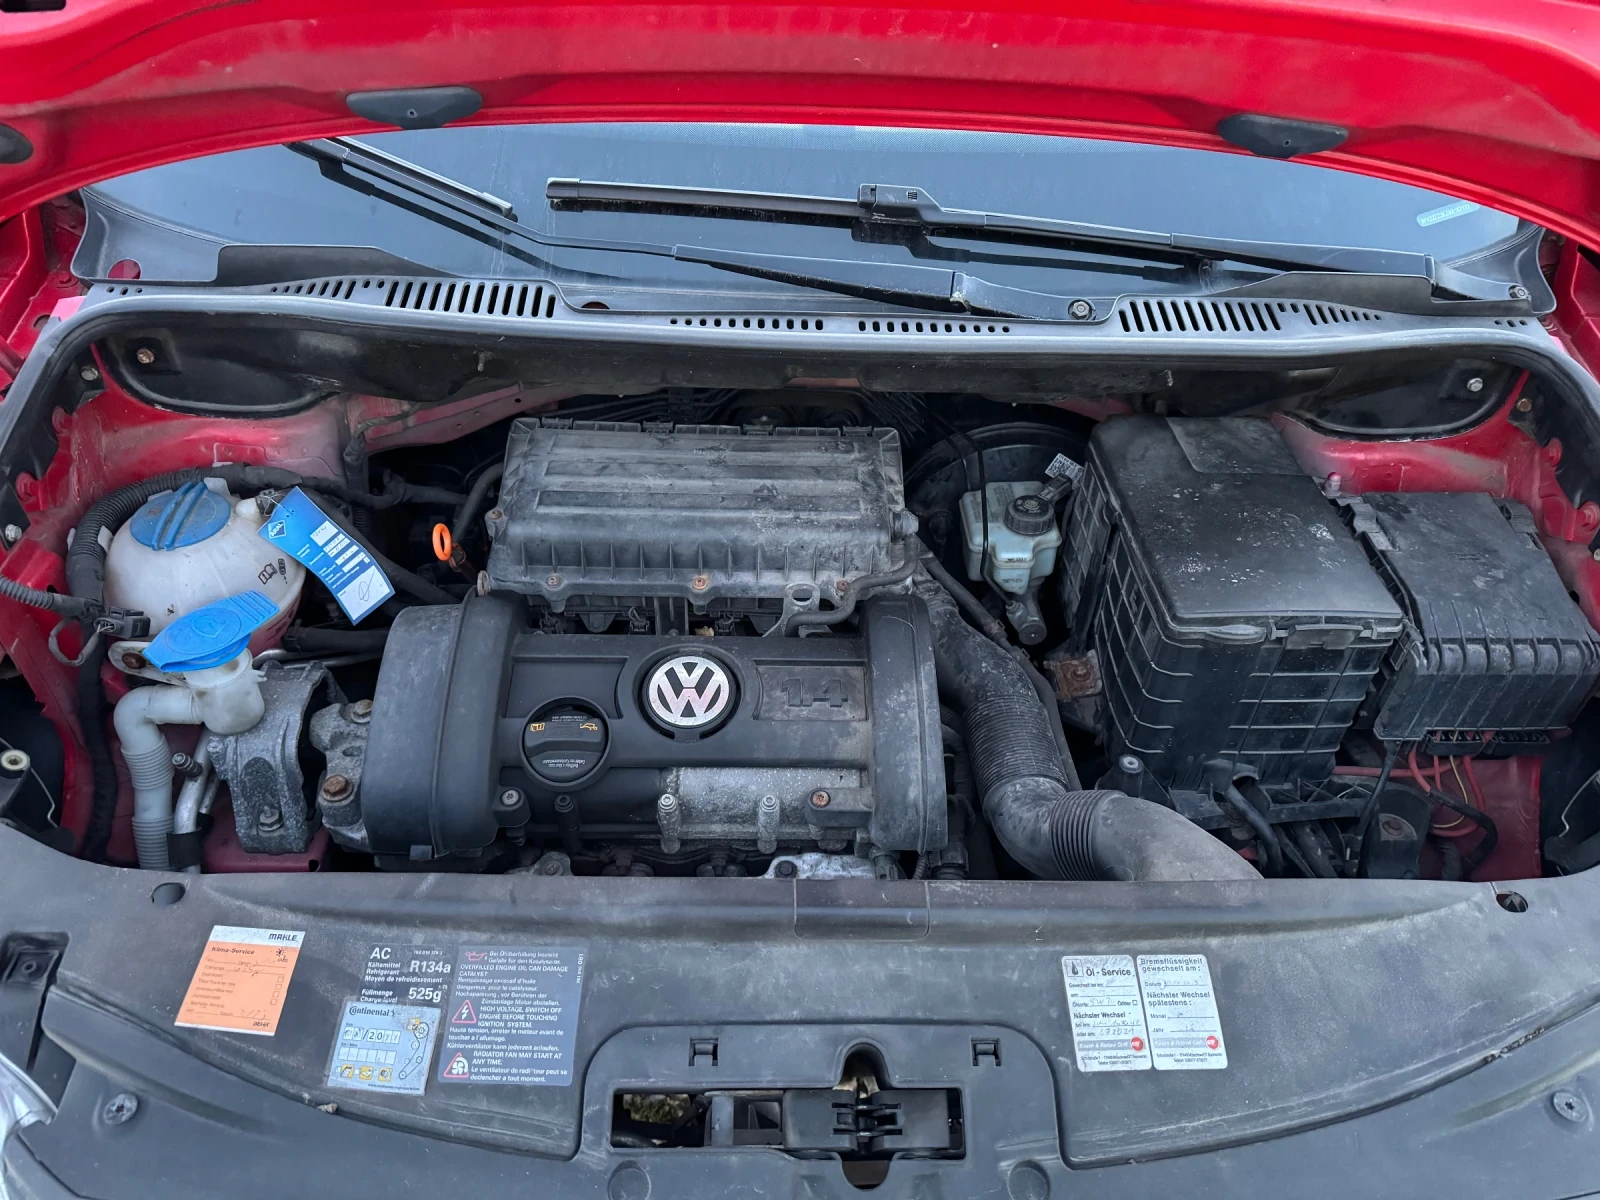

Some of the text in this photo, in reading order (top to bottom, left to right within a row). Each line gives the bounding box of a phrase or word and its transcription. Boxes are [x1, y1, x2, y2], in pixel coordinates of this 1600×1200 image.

[270, 521, 284, 537] ARAL
[268, 933, 298, 942] MAHLE
[211, 946, 255, 955] Klima-Service
[369, 947, 392, 960] AC
[409, 960, 452, 974] R134a
[1086, 966, 1095, 976] Öl
[1101, 968, 1131, 976] Service
[1142, 965, 1184, 973] gewechselt
[362, 987, 442, 1002] Füllmenge 525g
[349, 1006, 390, 1016] Continental
